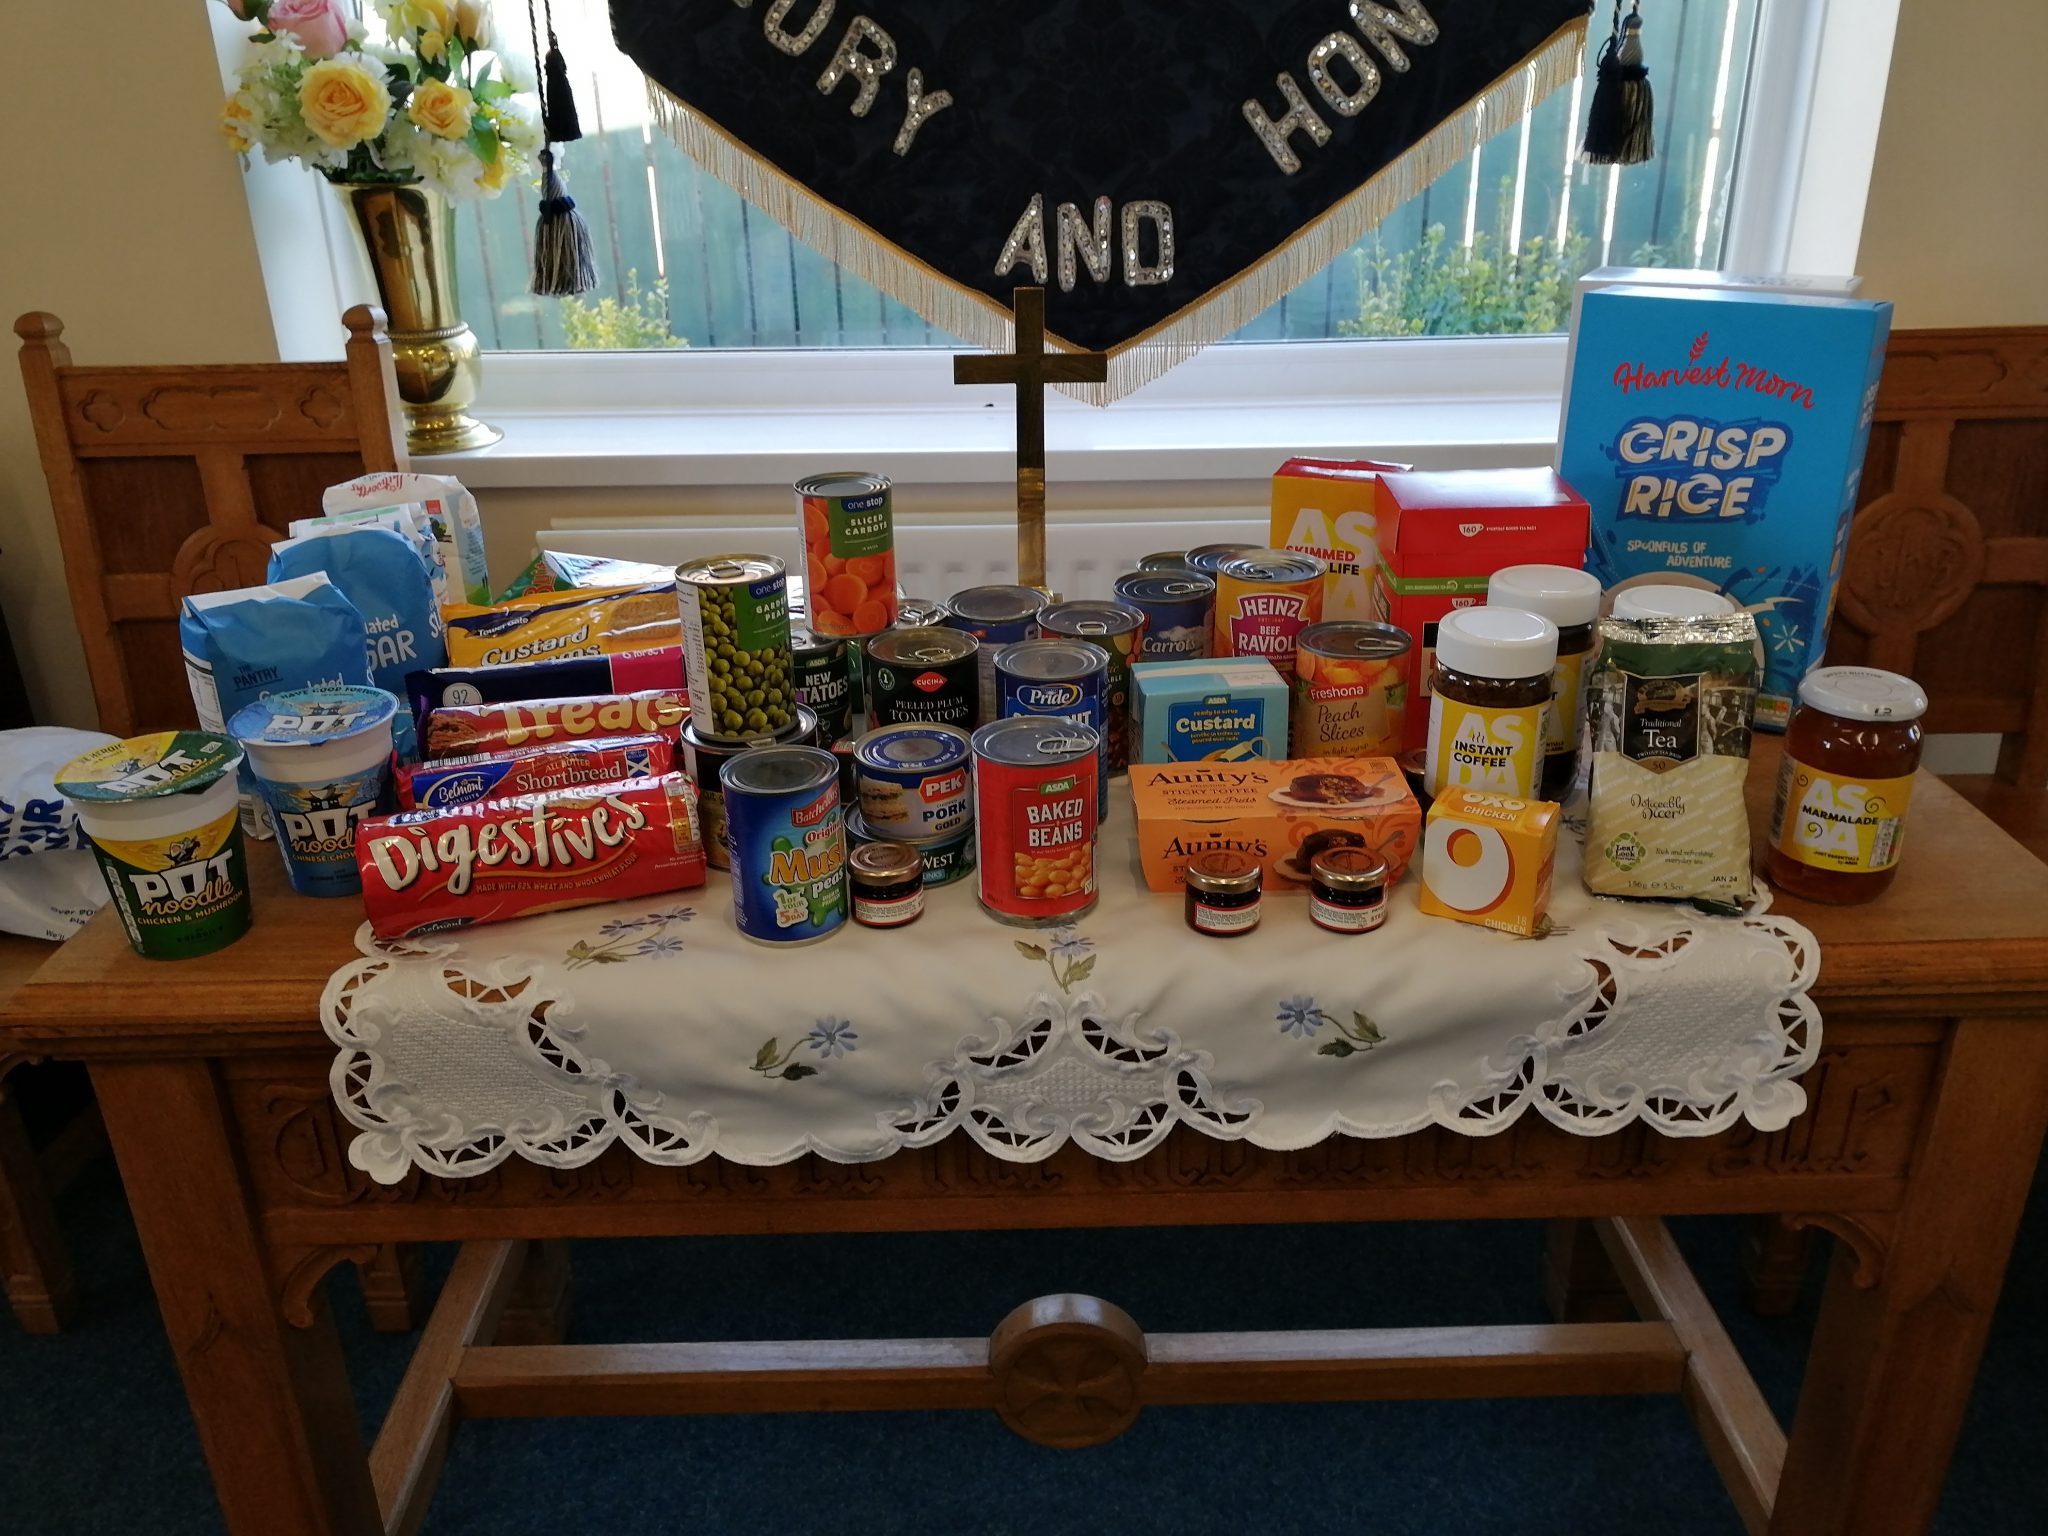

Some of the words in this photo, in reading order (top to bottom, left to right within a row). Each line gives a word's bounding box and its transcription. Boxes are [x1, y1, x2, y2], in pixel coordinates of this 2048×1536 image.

[737, 0, 952, 156] ORY
[994, 193, 1176, 292] AND
[1613, 357, 1731, 394] Harvest
[1735, 363, 1816, 410] Morn
[1618, 420, 1788, 471] CRISP
[847, 498, 865, 510] one
[866, 496, 883, 508] stop
[1624, 473, 1755, 518] RICE
[845, 522, 888, 536] CARROTS
[850, 513, 883, 527] SLICED
[1461, 525, 1477, 534] 160
[1286, 545, 1356, 562] SKIMMED
[1627, 539, 1688, 554] SPOONFULS
[1693, 541, 1708, 552] OF
[1329, 563, 1360, 576] LIFE
[1666, 554, 1733, 569] ADVENTURE
[755, 584, 772, 596] one
[772, 577, 787, 592] stop
[765, 610, 786, 623] PEAS
[1244, 598, 1300, 617] HEINZ
[1260, 626, 1281, 635] BEEF
[481, 625, 589, 667] Custard
[1142, 637, 1196, 653] Carrots
[1238, 633, 1296, 653] RAVIOL
[233, 666, 278, 688] PANTRY
[805, 671, 831, 687] NEW
[916, 677, 944, 686] CUCINA
[281, 690, 308, 699] HAVE
[452, 690, 469, 704] 92
[1030, 686, 1070, 705] Pride
[1311, 686, 1364, 700] Freshona
[895, 699, 934, 711] PEELED
[936, 697, 964, 709] PLUM
[1318, 701, 1360, 724] Peach
[888, 705, 969, 723] TOMATOES
[1176, 713, 1256, 733] Custard
[1640, 718, 1681, 728] Traditional
[1320, 723, 1365, 742] Slices
[1643, 728, 1677, 748] Tea
[1455, 740, 1514, 756] INSTANT
[545, 763, 559, 773] ALL
[560, 757, 591, 769] BUTTER
[1454, 752, 1507, 768] COFFEE
[515, 761, 623, 792] Shortbread
[925, 773, 964, 797] PEK
[1147, 769, 1269, 789] Aunty's
[437, 774, 484, 803] Belmont
[1044, 782, 1071, 793] ASDA
[1168, 797, 1220, 806] Steamed
[1223, 796, 1257, 805] Puds
[1462, 792, 1526, 811] OXO
[922, 799, 966, 823] PORK
[1026, 798, 1084, 825] BAKED
[1463, 804, 1517, 822] CHICKEN
[1802, 804, 1879, 826] MARMALADE
[281, 800, 378, 842] POT
[935, 817, 961, 832] GOLD
[291, 828, 356, 853] nood
[1028, 820, 1083, 848] BEANS
[367, 795, 646, 896] Digestives
[293, 854, 327, 862] CHINESE
[128, 848, 234, 903] POT
[812, 868, 844, 898] peas
[477, 882, 496, 892] MADE
[497, 881, 515, 890] WITH
[534, 881, 557, 890] WHEAT
[559, 881, 574, 890] AND
[141, 879, 235, 916] noodle
[783, 899, 804, 910] YOUR
[137, 914, 181, 926] CHICKEN
[185, 911, 192, 921] &
[195, 890, 244, 919] MUSHROOM
[779, 910, 791, 923] 5
[790, 912, 805, 922] DAY
[1484, 918, 1527, 935] CHICKEN
[1516, 915, 1527, 926] 18
